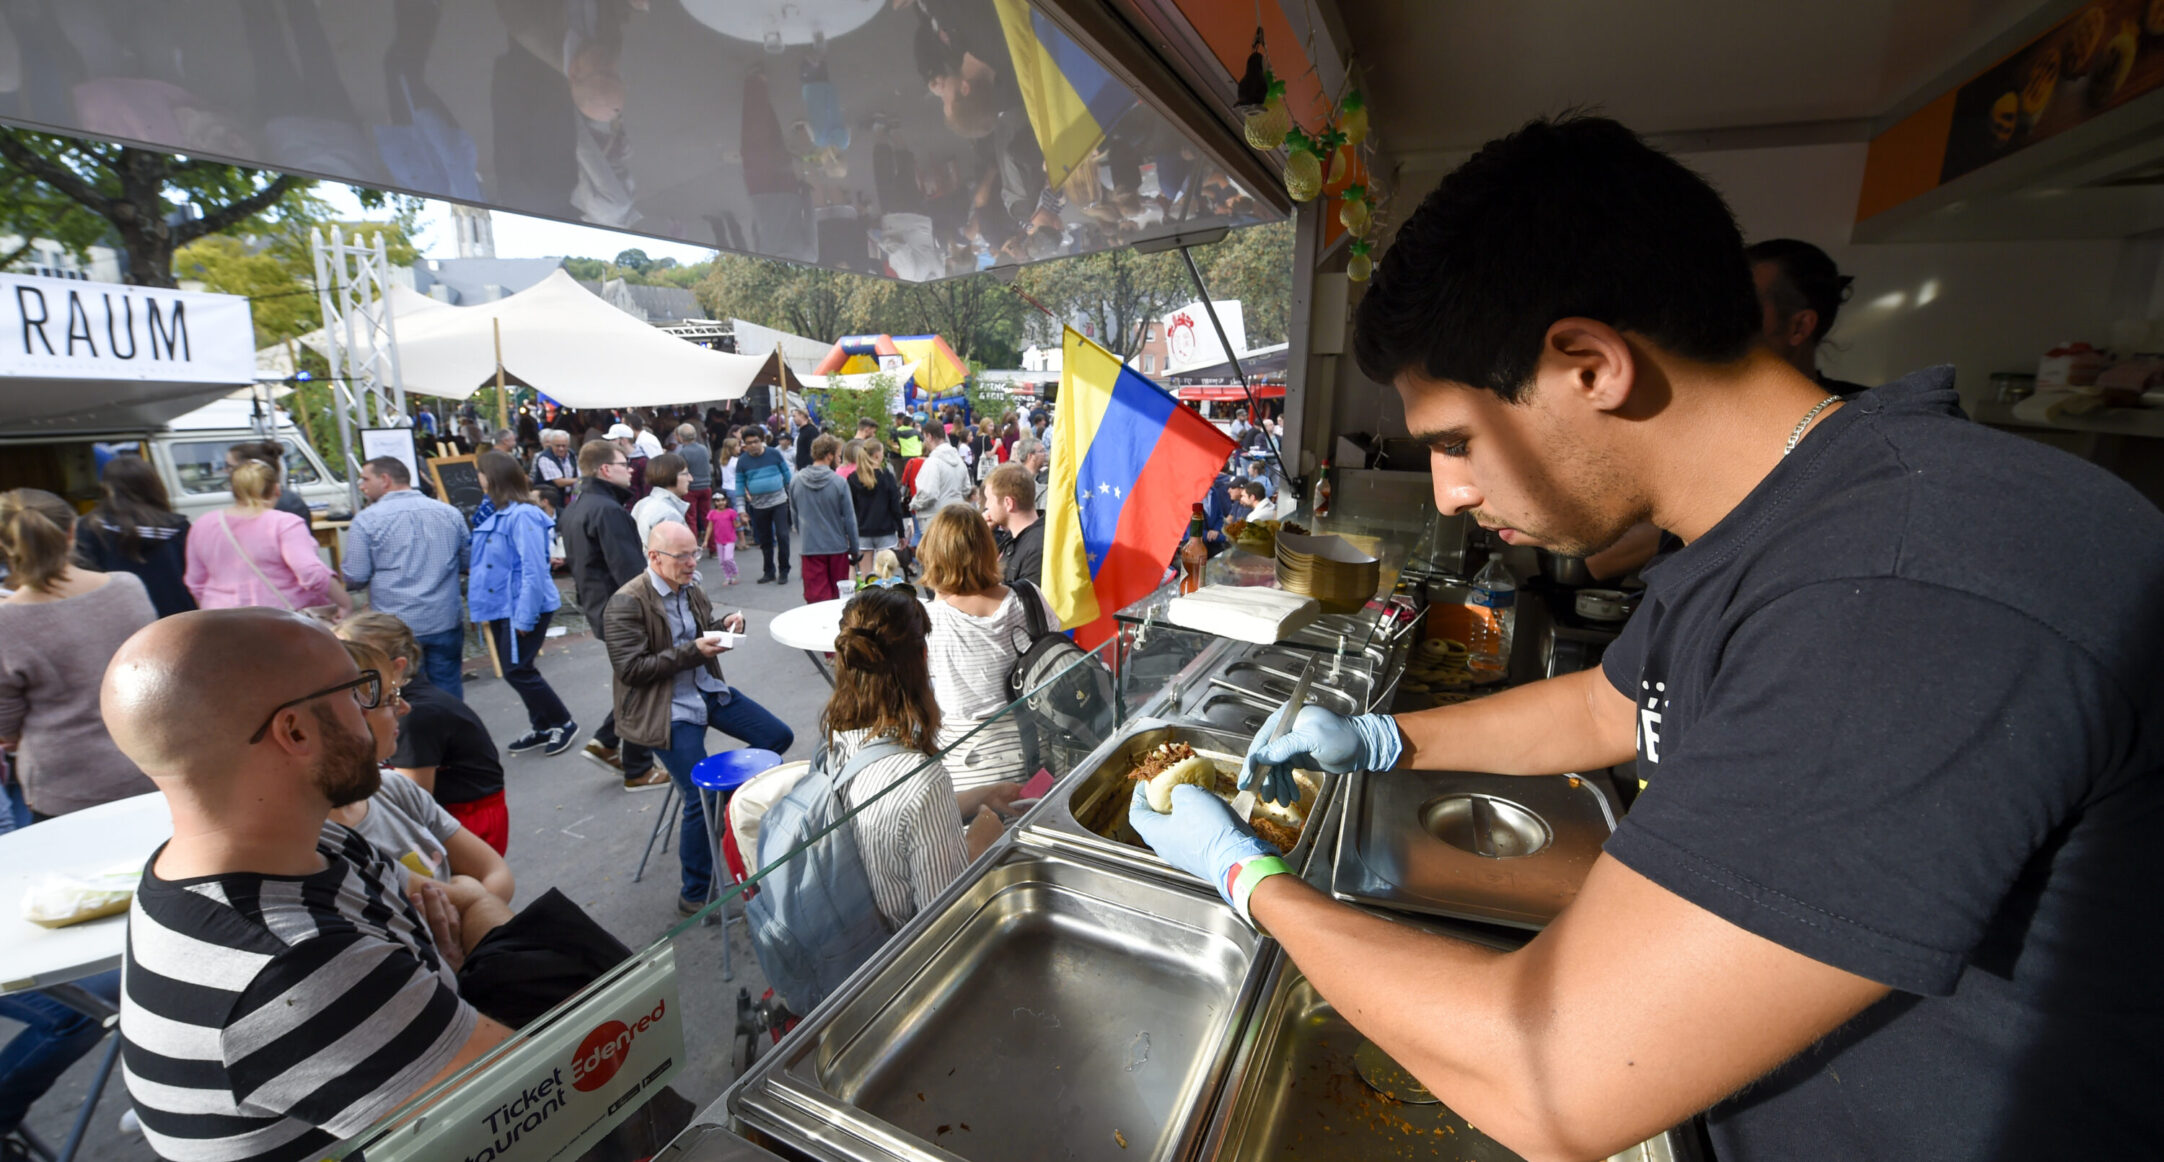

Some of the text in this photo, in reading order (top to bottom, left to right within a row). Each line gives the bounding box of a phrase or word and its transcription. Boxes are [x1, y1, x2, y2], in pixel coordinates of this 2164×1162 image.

[16, 285, 190, 362] RAUM
[571, 998, 665, 1082] Edenred
[481, 1067, 562, 1135] Ticket
